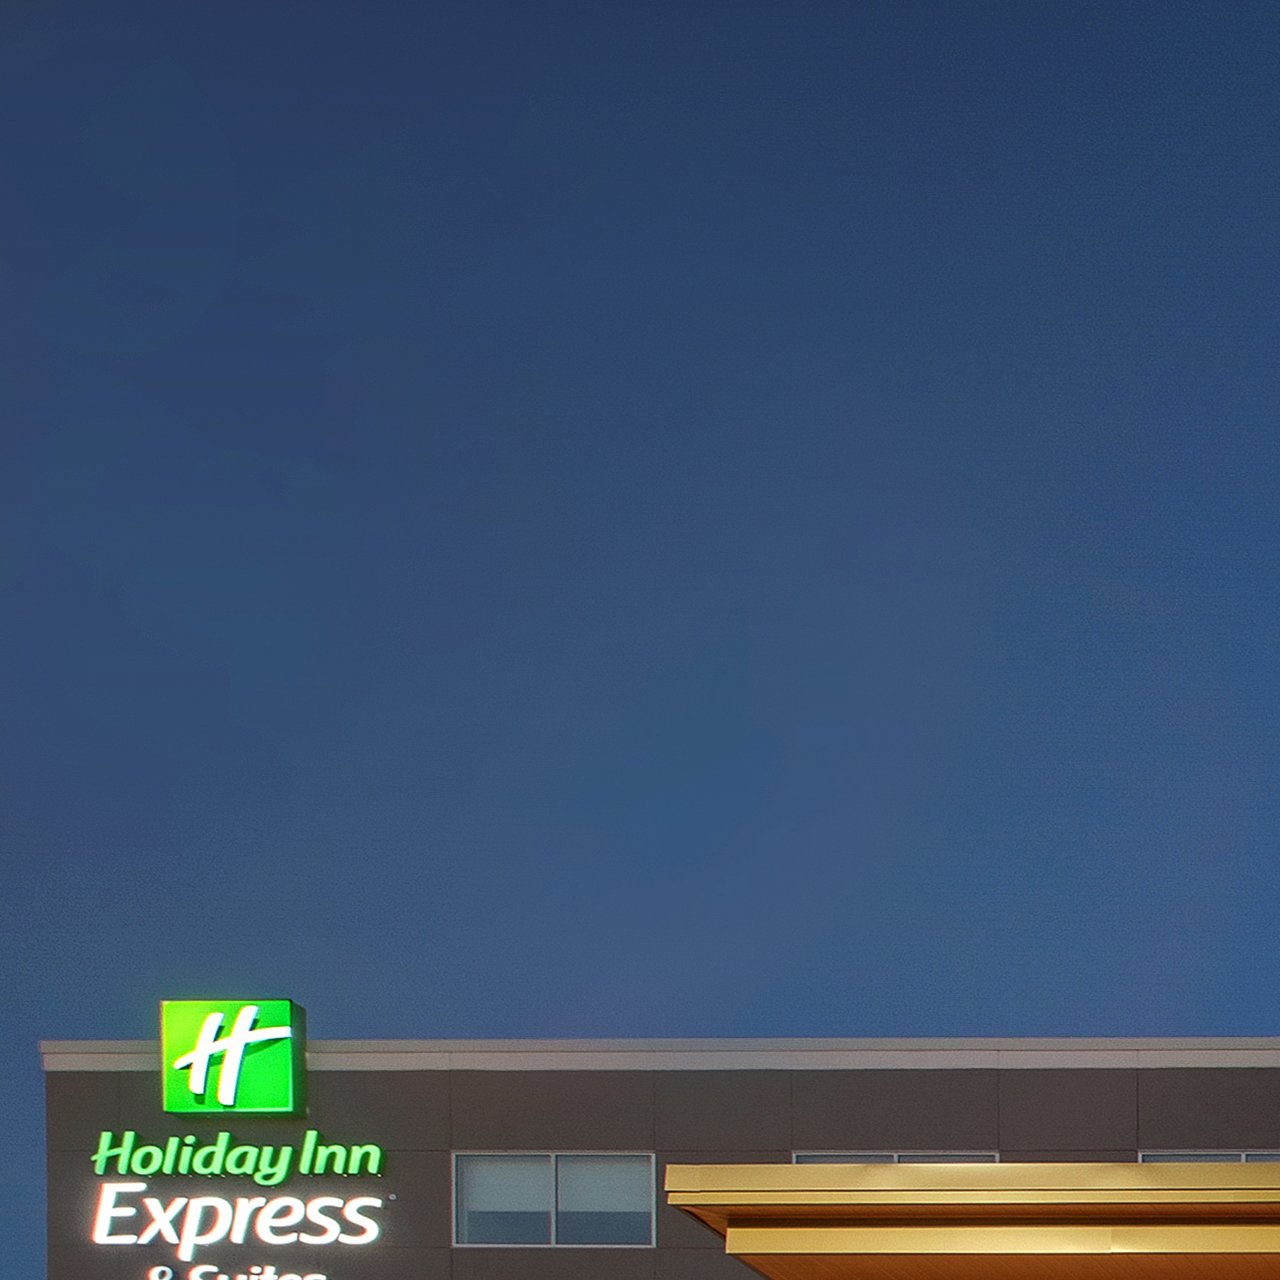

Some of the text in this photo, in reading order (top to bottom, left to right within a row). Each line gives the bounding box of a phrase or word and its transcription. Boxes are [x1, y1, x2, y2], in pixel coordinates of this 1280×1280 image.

[91, 1130, 382, 1185] Holiday Inn
[91, 1182, 383, 1262] Express
